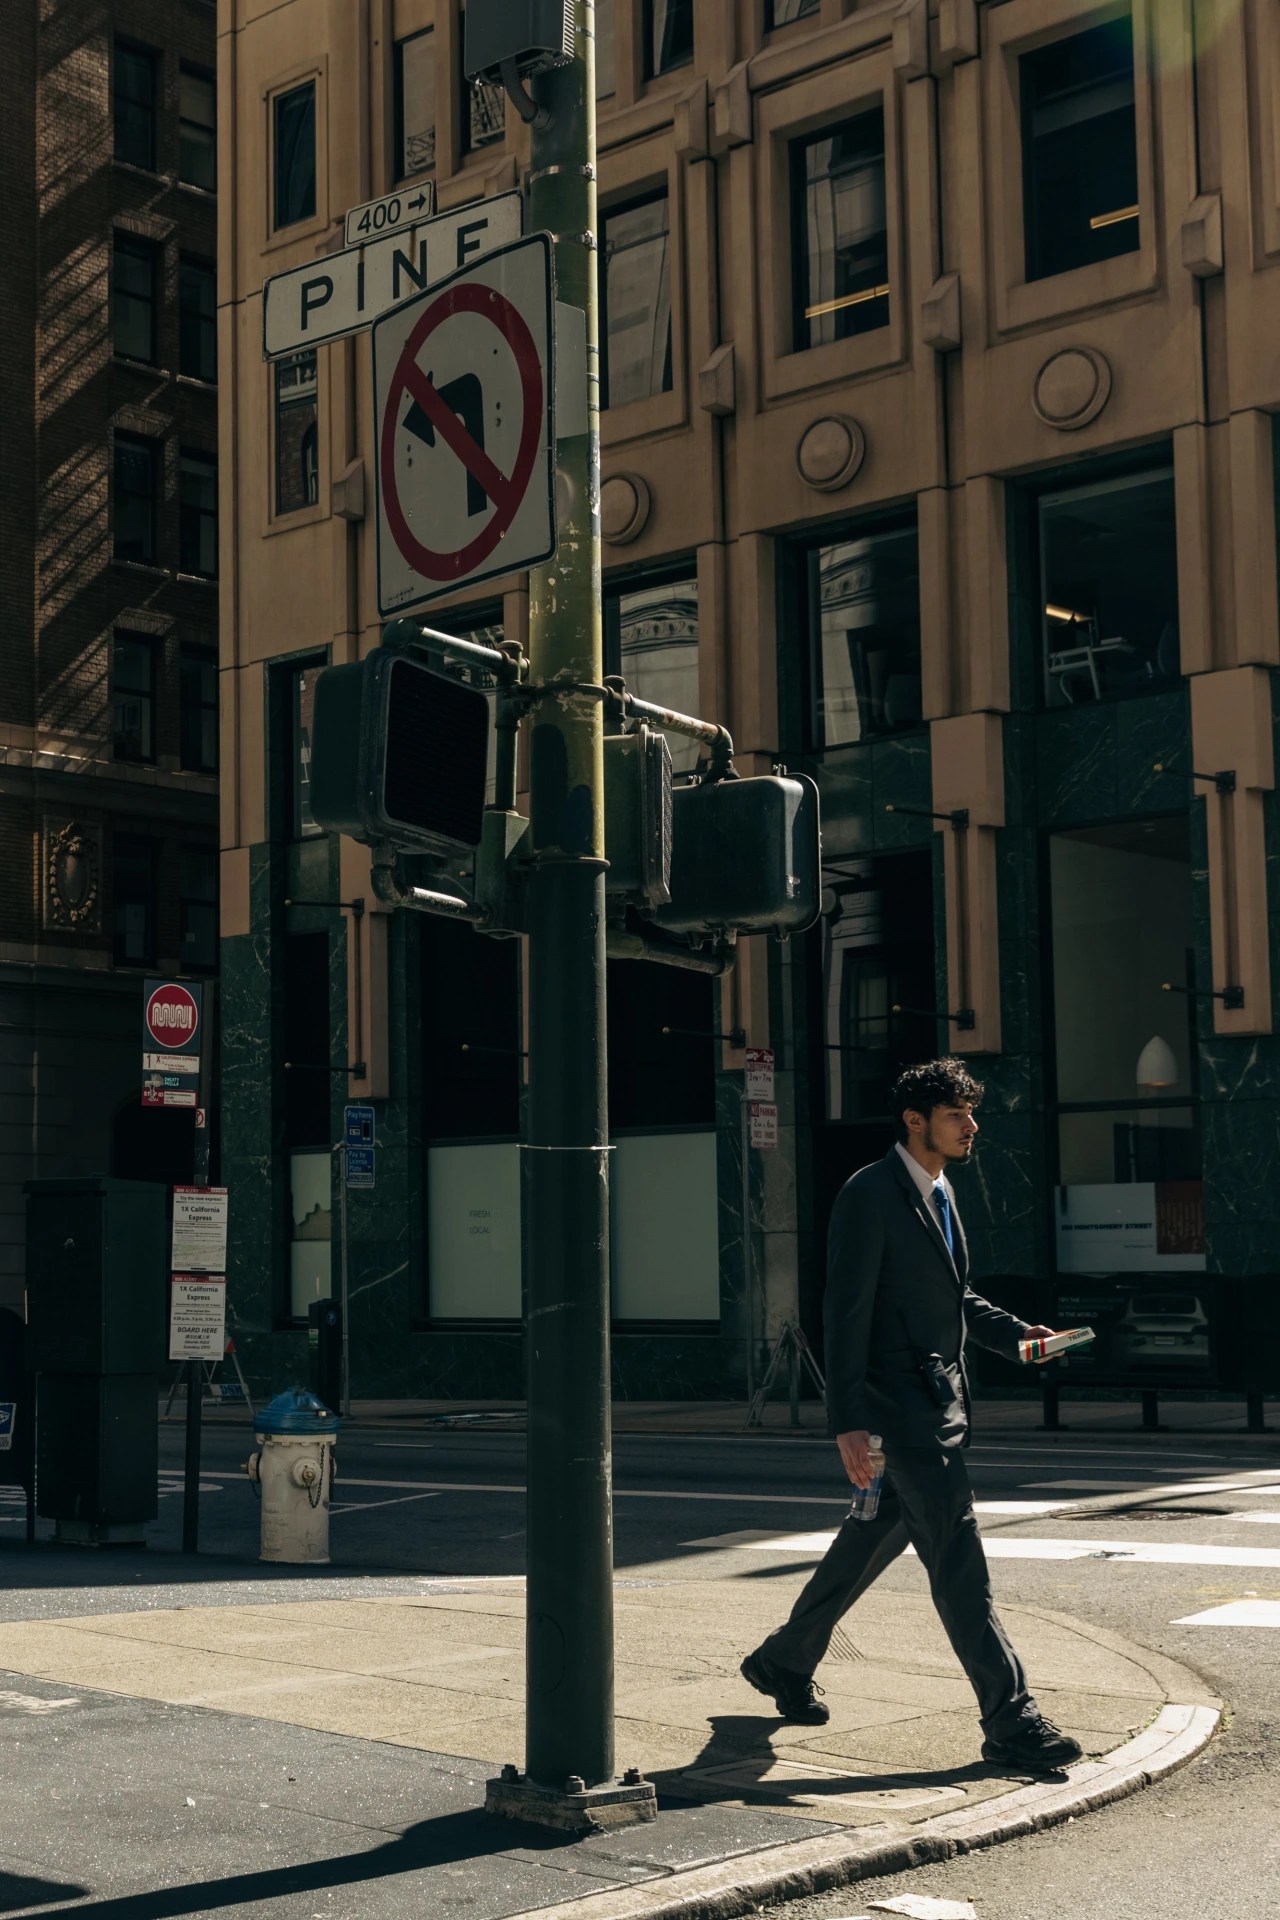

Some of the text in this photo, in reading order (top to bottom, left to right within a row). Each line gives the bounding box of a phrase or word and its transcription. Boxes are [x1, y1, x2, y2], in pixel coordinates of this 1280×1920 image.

[357, 198, 401, 234] 400
[348, 1110, 358, 1120] Pay
[470, 1210, 491, 1218] FRESH
[470, 1226, 490, 1234] LOCAL
